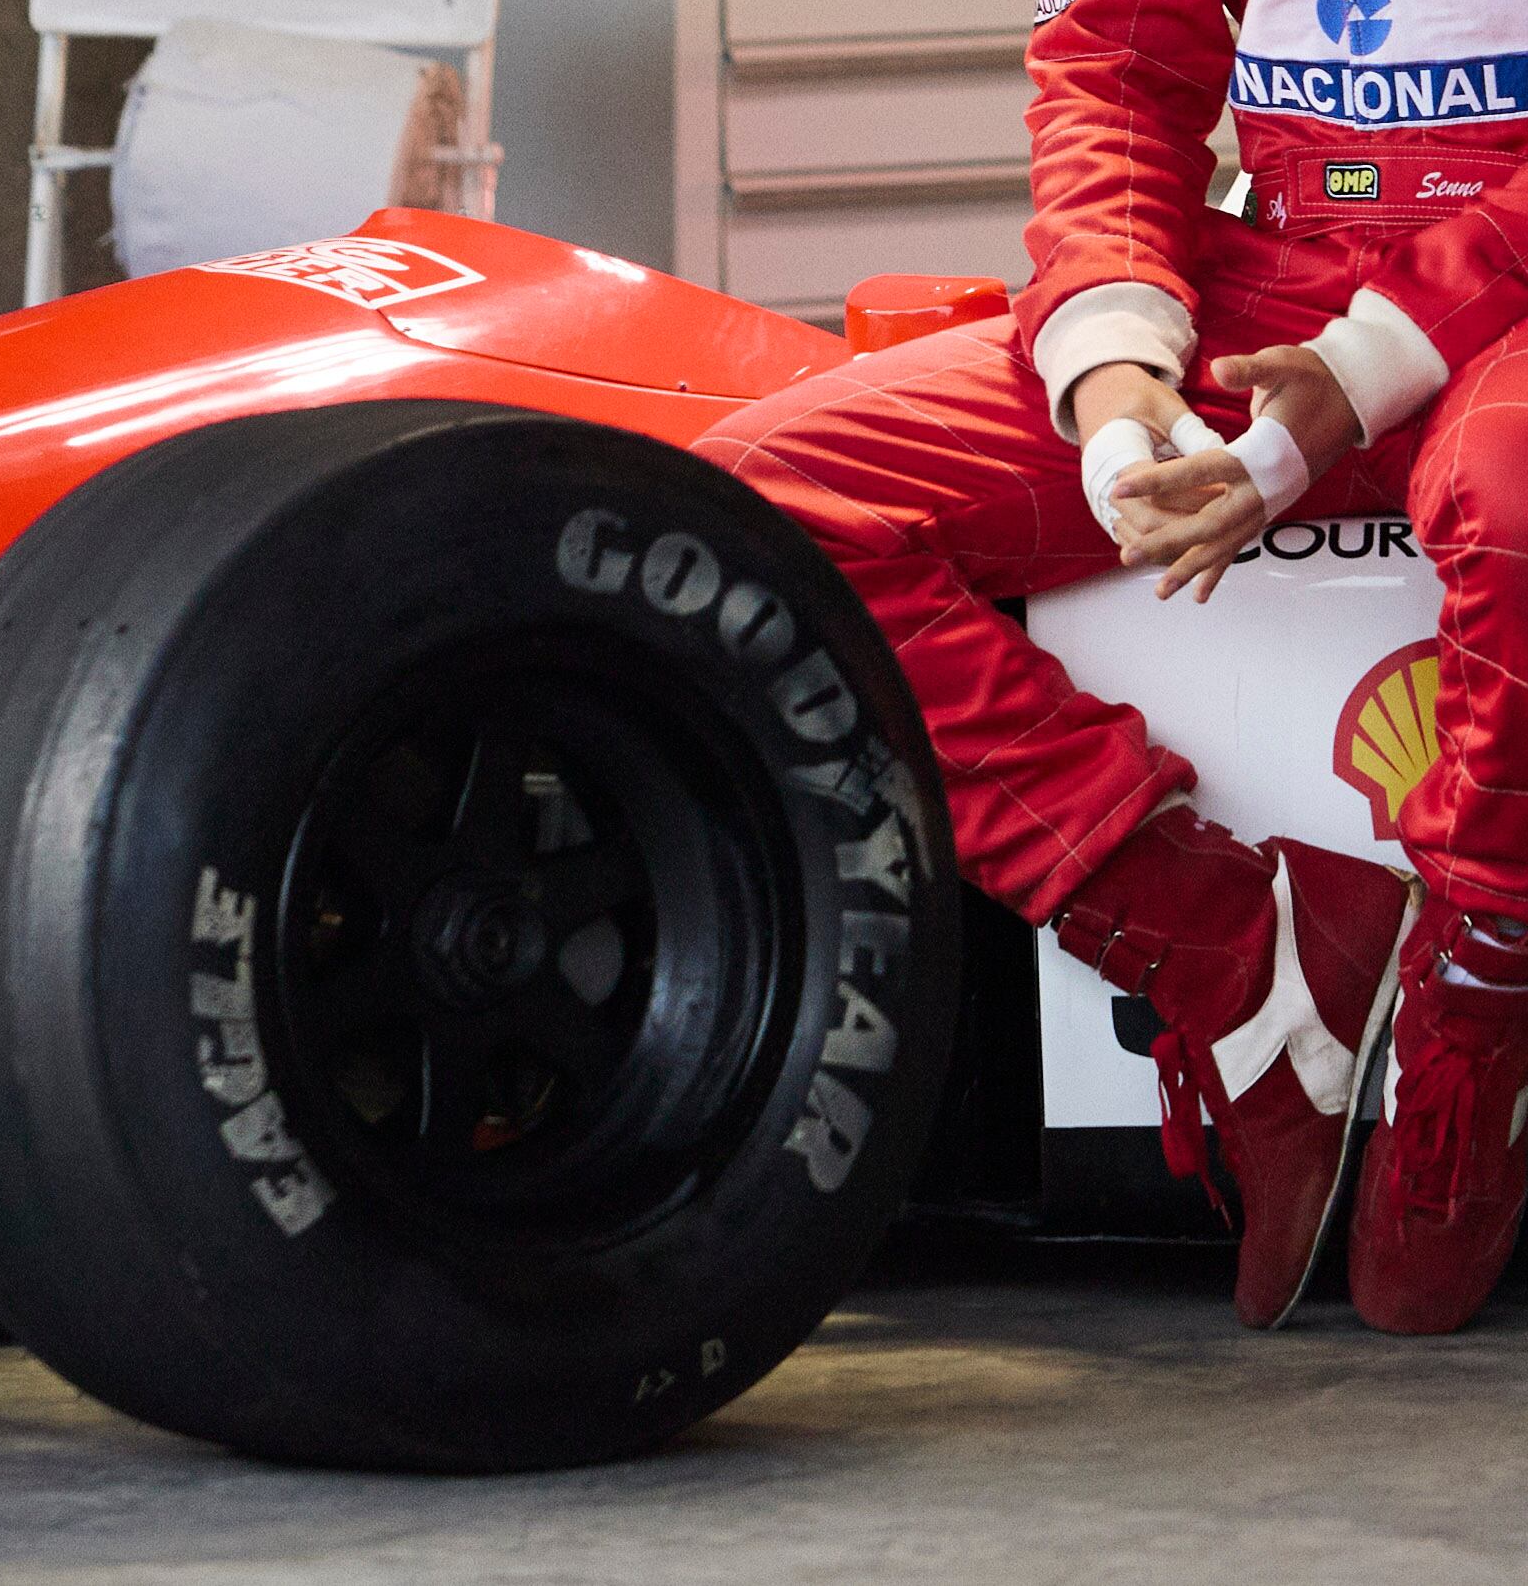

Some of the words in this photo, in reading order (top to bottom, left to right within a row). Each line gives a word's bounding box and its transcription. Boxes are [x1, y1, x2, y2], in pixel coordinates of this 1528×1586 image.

[1234, 57, 1517, 120] NACIONAL
[1231, 521, 1419, 564] OUR
[556, 506, 917, 1194] GOODYEAR
[189, 864, 338, 1237] EAGLE
